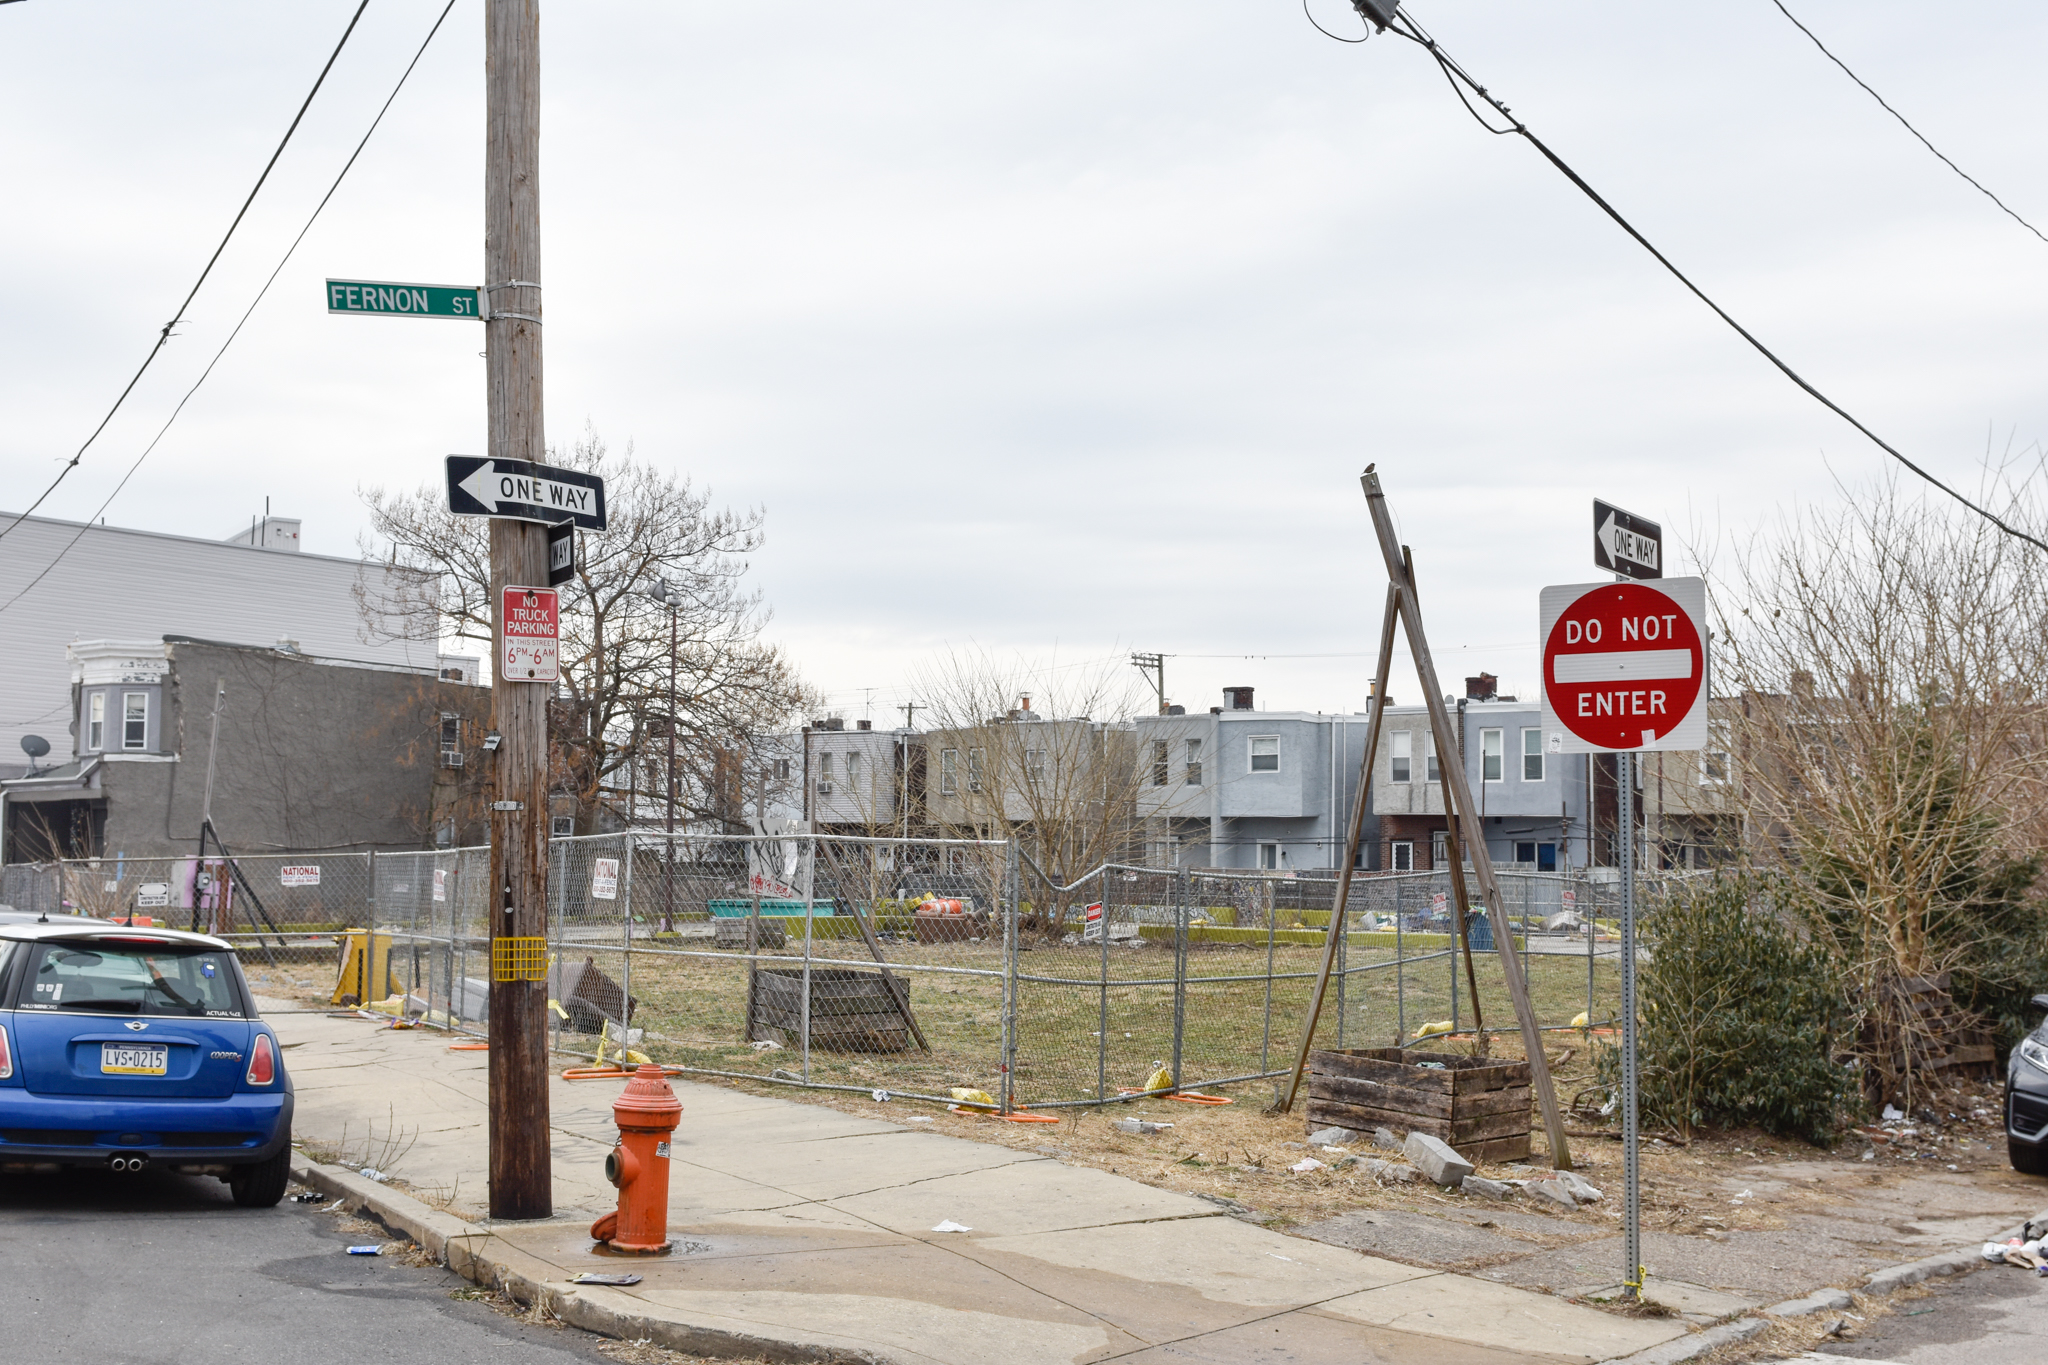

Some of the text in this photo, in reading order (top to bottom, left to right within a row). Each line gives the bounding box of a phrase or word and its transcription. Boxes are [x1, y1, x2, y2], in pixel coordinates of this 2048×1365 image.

[331, 285, 472, 314] FERNON ST
[501, 477, 588, 510] ONE WAY
[552, 541, 568, 567] WAY
[1614, 528, 1655, 565] ONE WAY
[522, 595, 539, 608] NO
[507, 621, 555, 635] PARKING
[512, 608, 549, 622] TRUCK
[1566, 614, 1677, 644] DO NOT
[1578, 690, 1667, 717] ENTER
[282, 866, 319, 876] NATIONAL
[210, 1051, 238, 1060] COOPER
